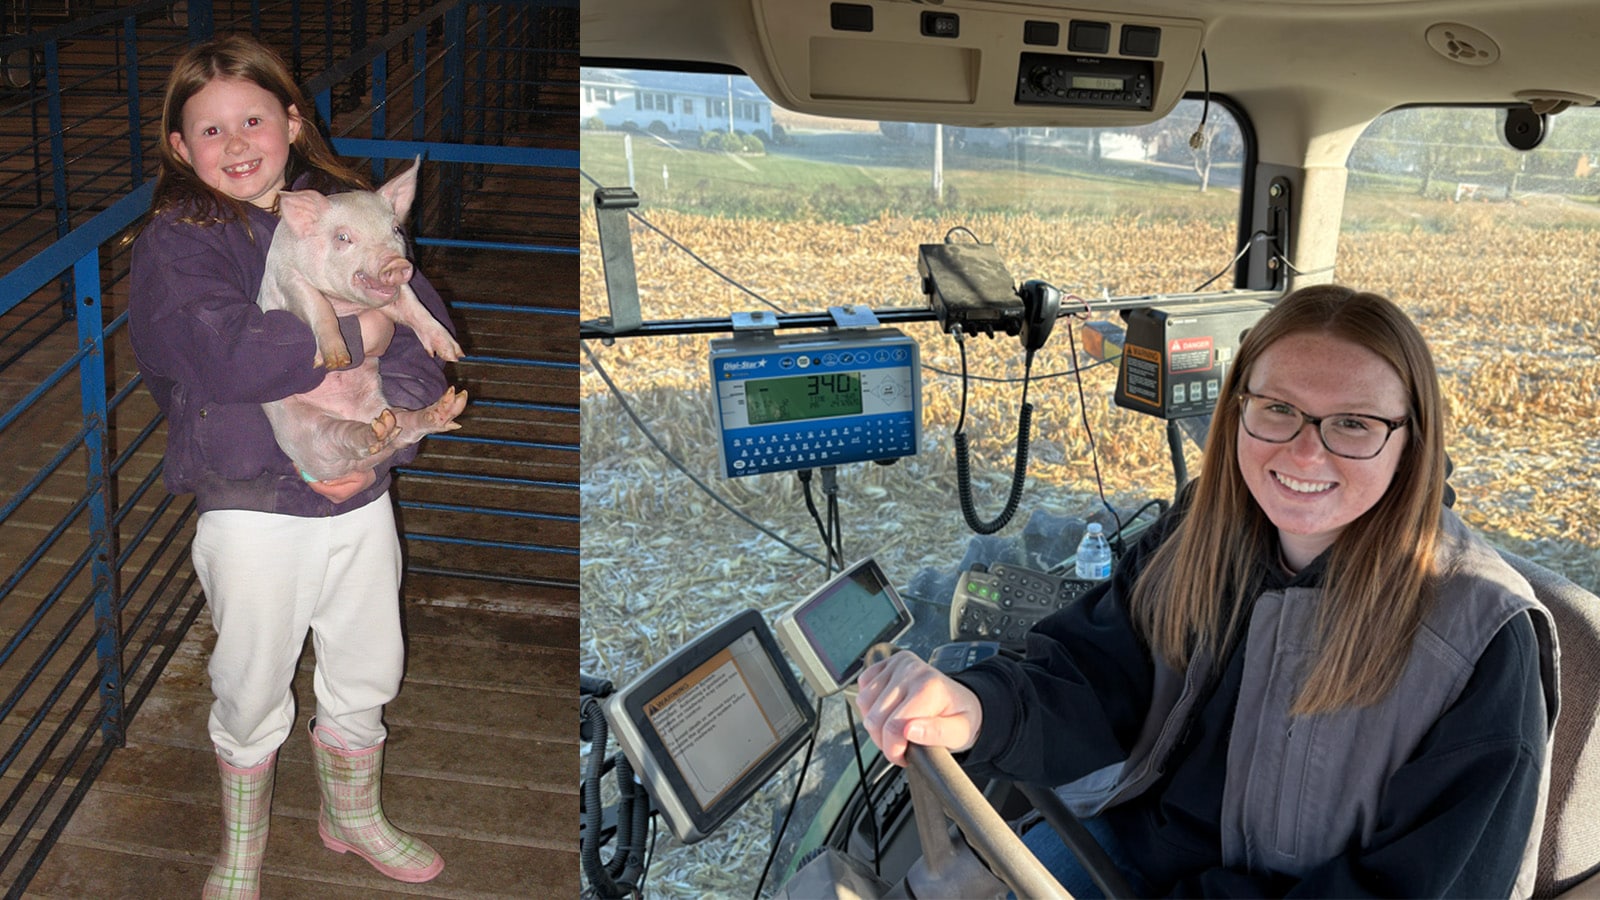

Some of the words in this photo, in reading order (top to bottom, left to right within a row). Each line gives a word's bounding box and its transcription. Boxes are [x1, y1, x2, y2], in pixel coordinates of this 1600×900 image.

[1183, 341, 1210, 349] DANGER
[723, 360, 760, 371] Digi-Star
[656, 681, 689, 707] WARNING
